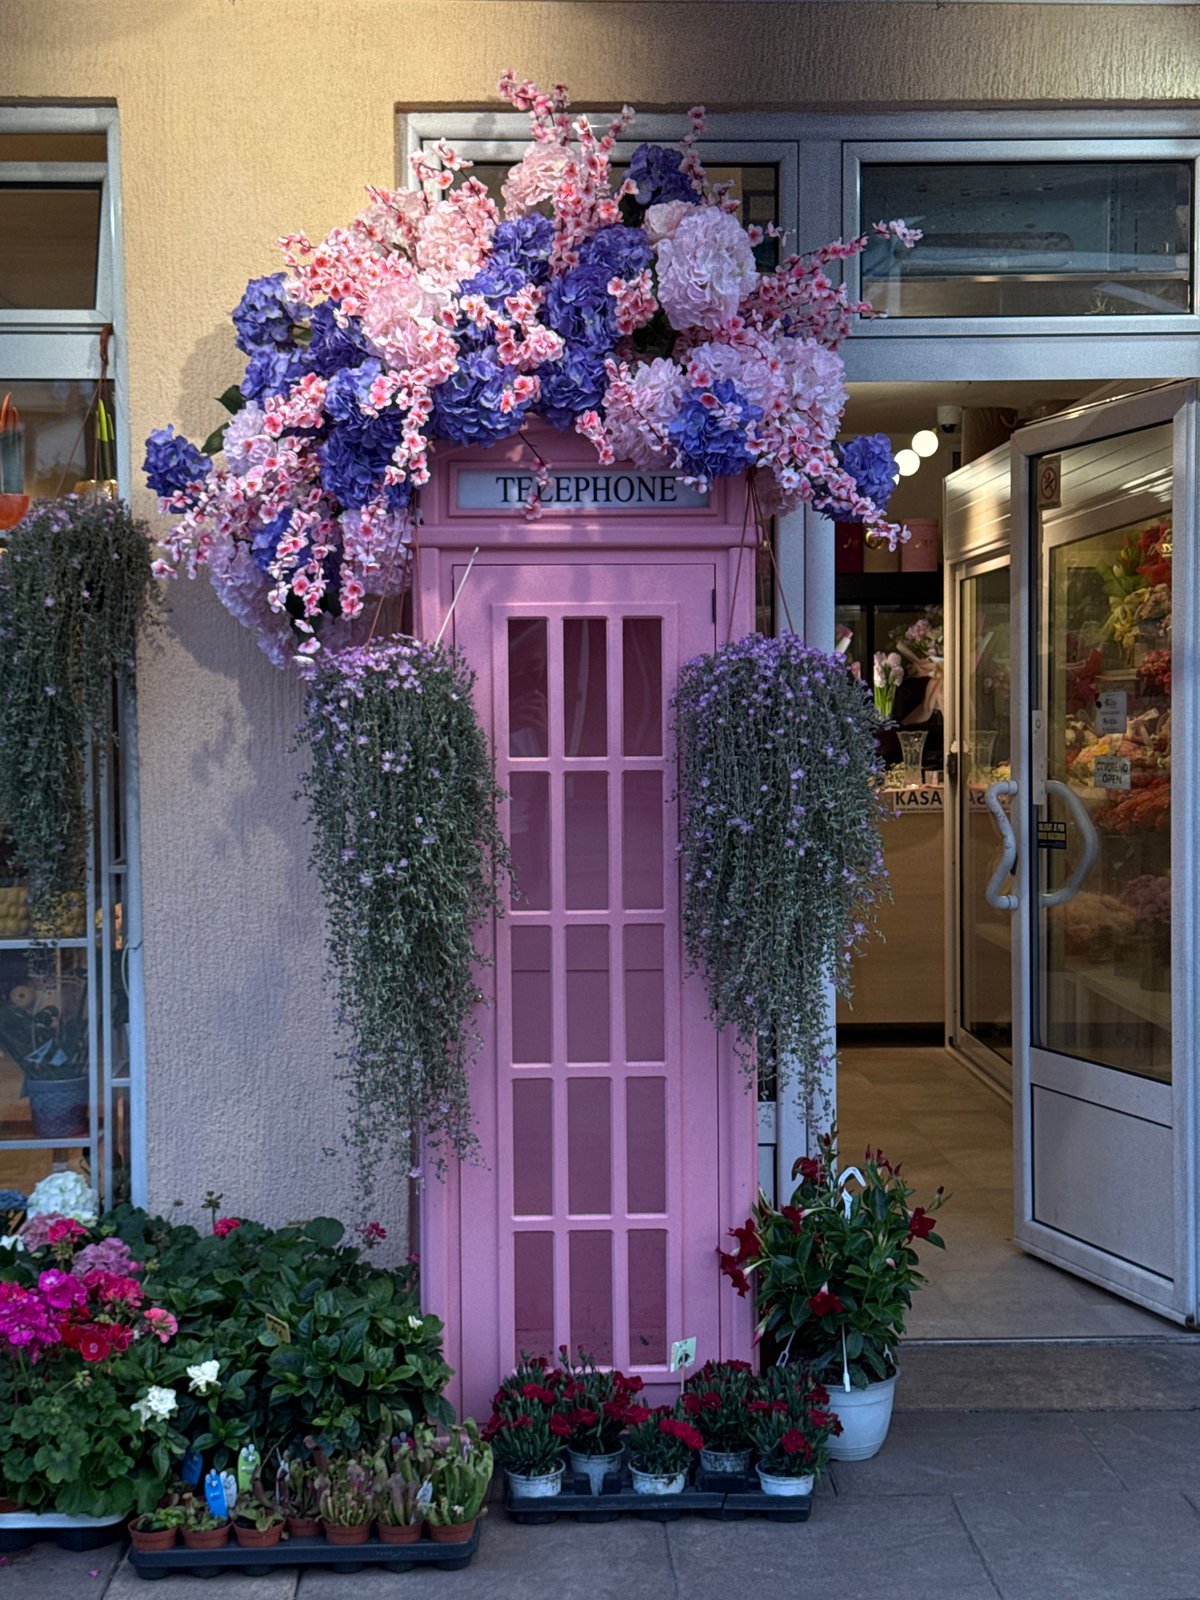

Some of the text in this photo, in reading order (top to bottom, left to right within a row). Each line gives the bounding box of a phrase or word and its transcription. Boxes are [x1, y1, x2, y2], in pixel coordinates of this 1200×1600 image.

[496, 475, 677, 503] TELEPHONE
[1102, 773, 1122, 784] OPEN
[896, 791, 943, 805] KASA
